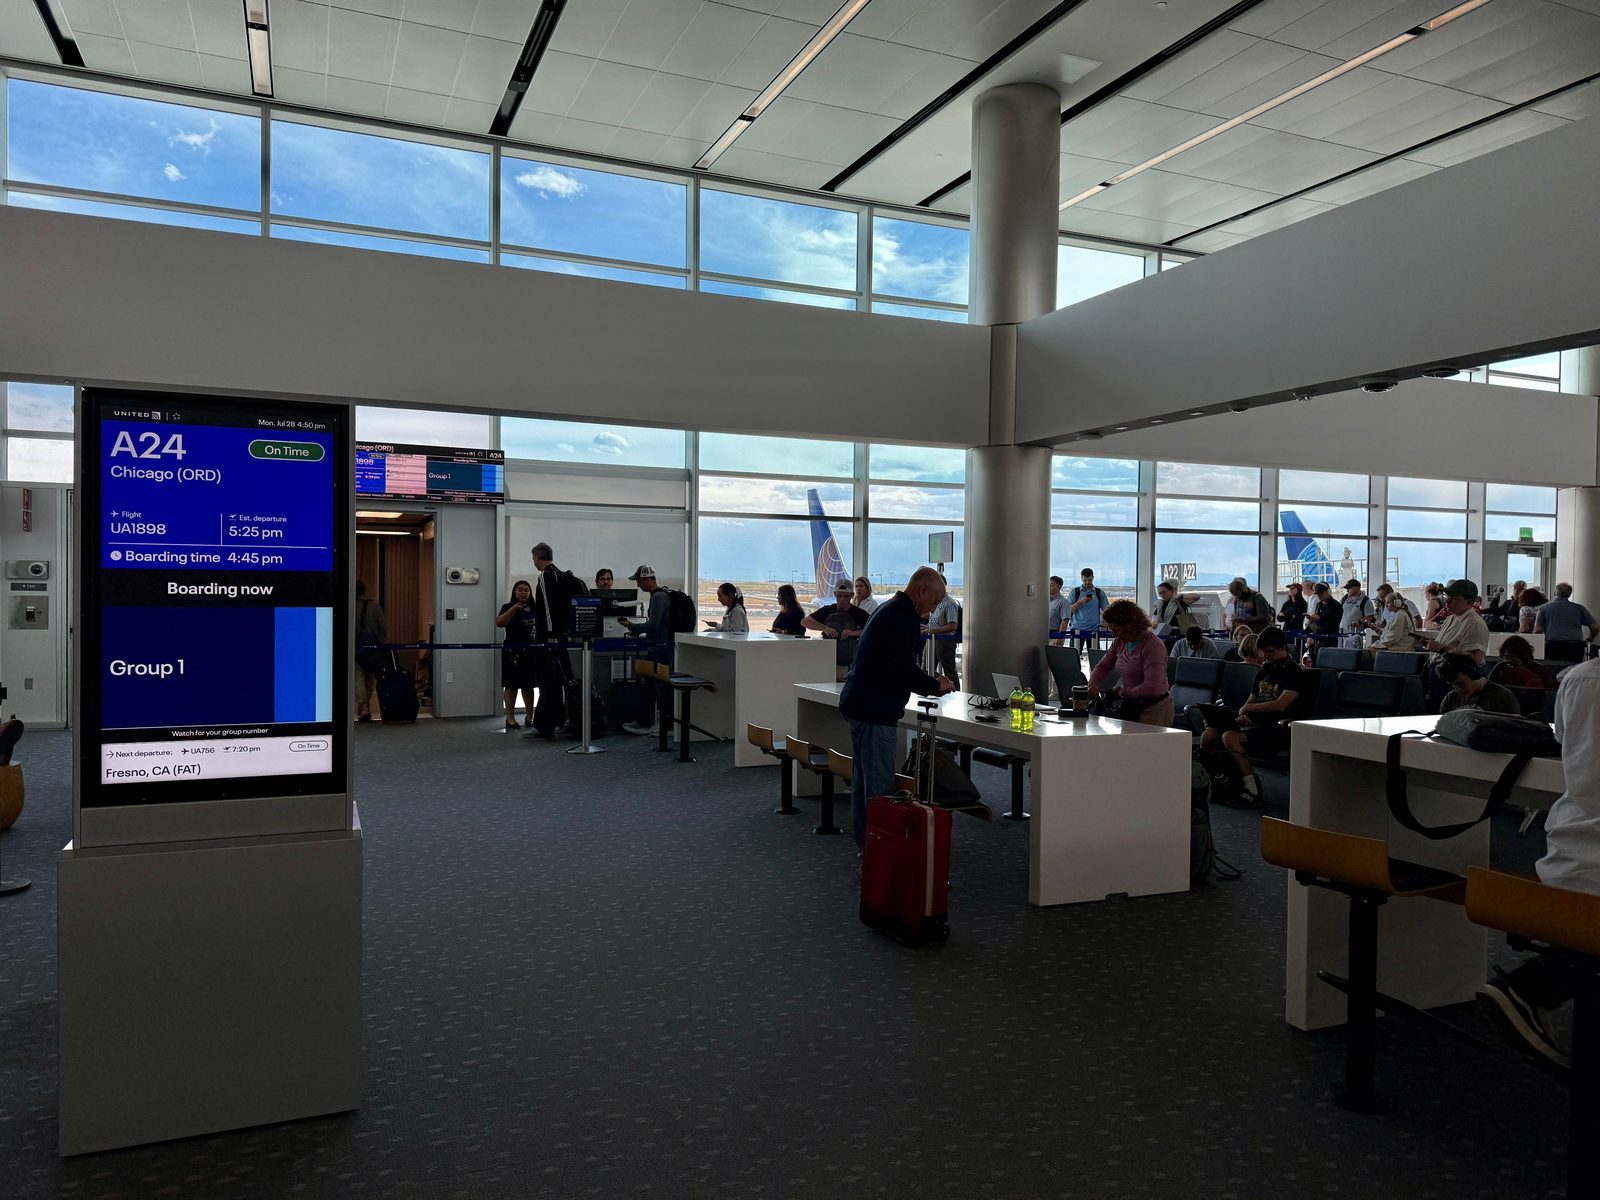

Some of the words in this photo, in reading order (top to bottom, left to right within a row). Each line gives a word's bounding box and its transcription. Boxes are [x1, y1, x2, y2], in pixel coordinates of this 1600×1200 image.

[113, 410, 150, 418] UNITED
[277, 419, 285, 427] Jul
[110, 430, 187, 460] A24
[264, 445, 283, 456] On
[283, 446, 310, 457] Time
[110, 465, 174, 482] Chicago
[177, 467, 222, 484] (ORD)
[428, 472, 448, 480] Group
[122, 510, 142, 519] Flight
[253, 515, 287, 524] departure
[110, 522, 166, 535] UA1898
[228, 525, 260, 538] 5:25
[262, 528, 283, 540] pm
[125, 550, 188, 565] Boarding
[190, 552, 221, 563] time
[227, 552, 260, 564] 4:45
[262, 555, 283, 566] pm
[1163, 564, 1179, 579] A22
[1183, 564, 1196, 580] A22
[167, 582, 238, 598] Boarding
[240, 585, 274, 595] now
[109, 659, 174, 678] Group
[177, 659, 185, 674] 1
[205, 730, 221, 738] your
[222, 729, 243, 737] group
[115, 750, 137, 758] Next
[137, 749, 173, 759] departure:
[248, 746, 261, 754] pm
[106, 766, 149, 778] Fresno,
[152, 765, 171, 776] CA
[173, 763, 201, 777] (FAT)
